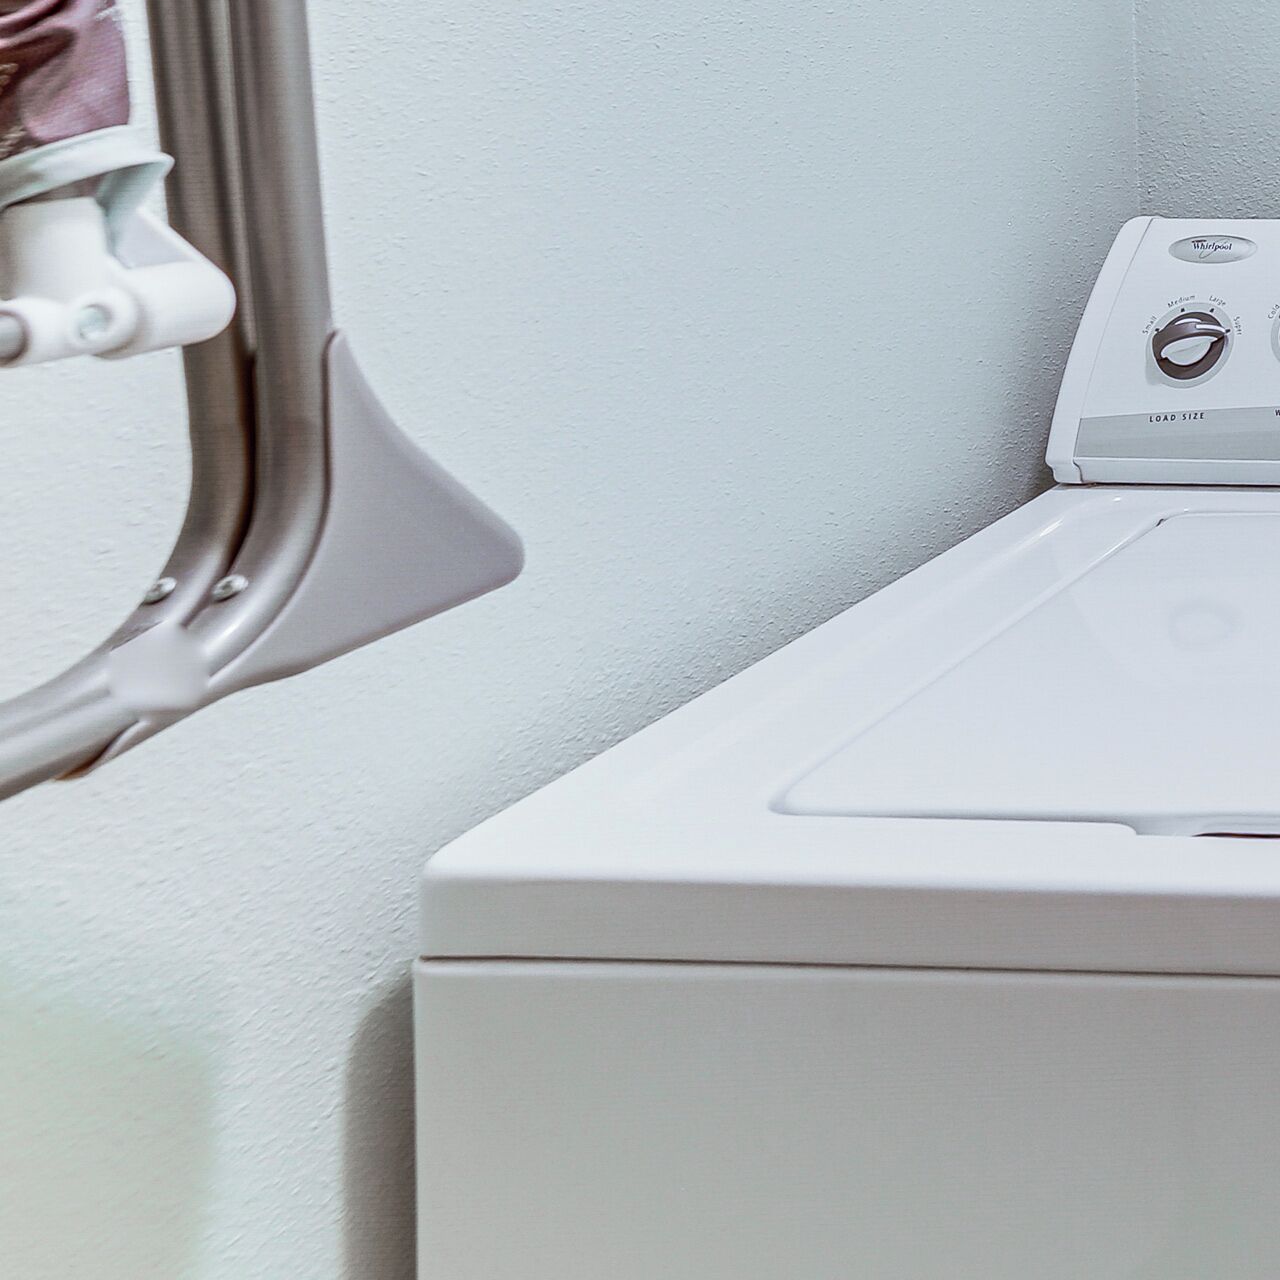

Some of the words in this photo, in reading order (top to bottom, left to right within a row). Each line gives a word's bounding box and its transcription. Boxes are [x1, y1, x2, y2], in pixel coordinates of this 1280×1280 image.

[1192, 240, 1232, 252] Whirlpool
[1167, 295, 1196, 308] Medium
[1142, 315, 1158, 335] Small
[1149, 415, 1177, 423] LOAD
[1182, 412, 1206, 420] SIZE
